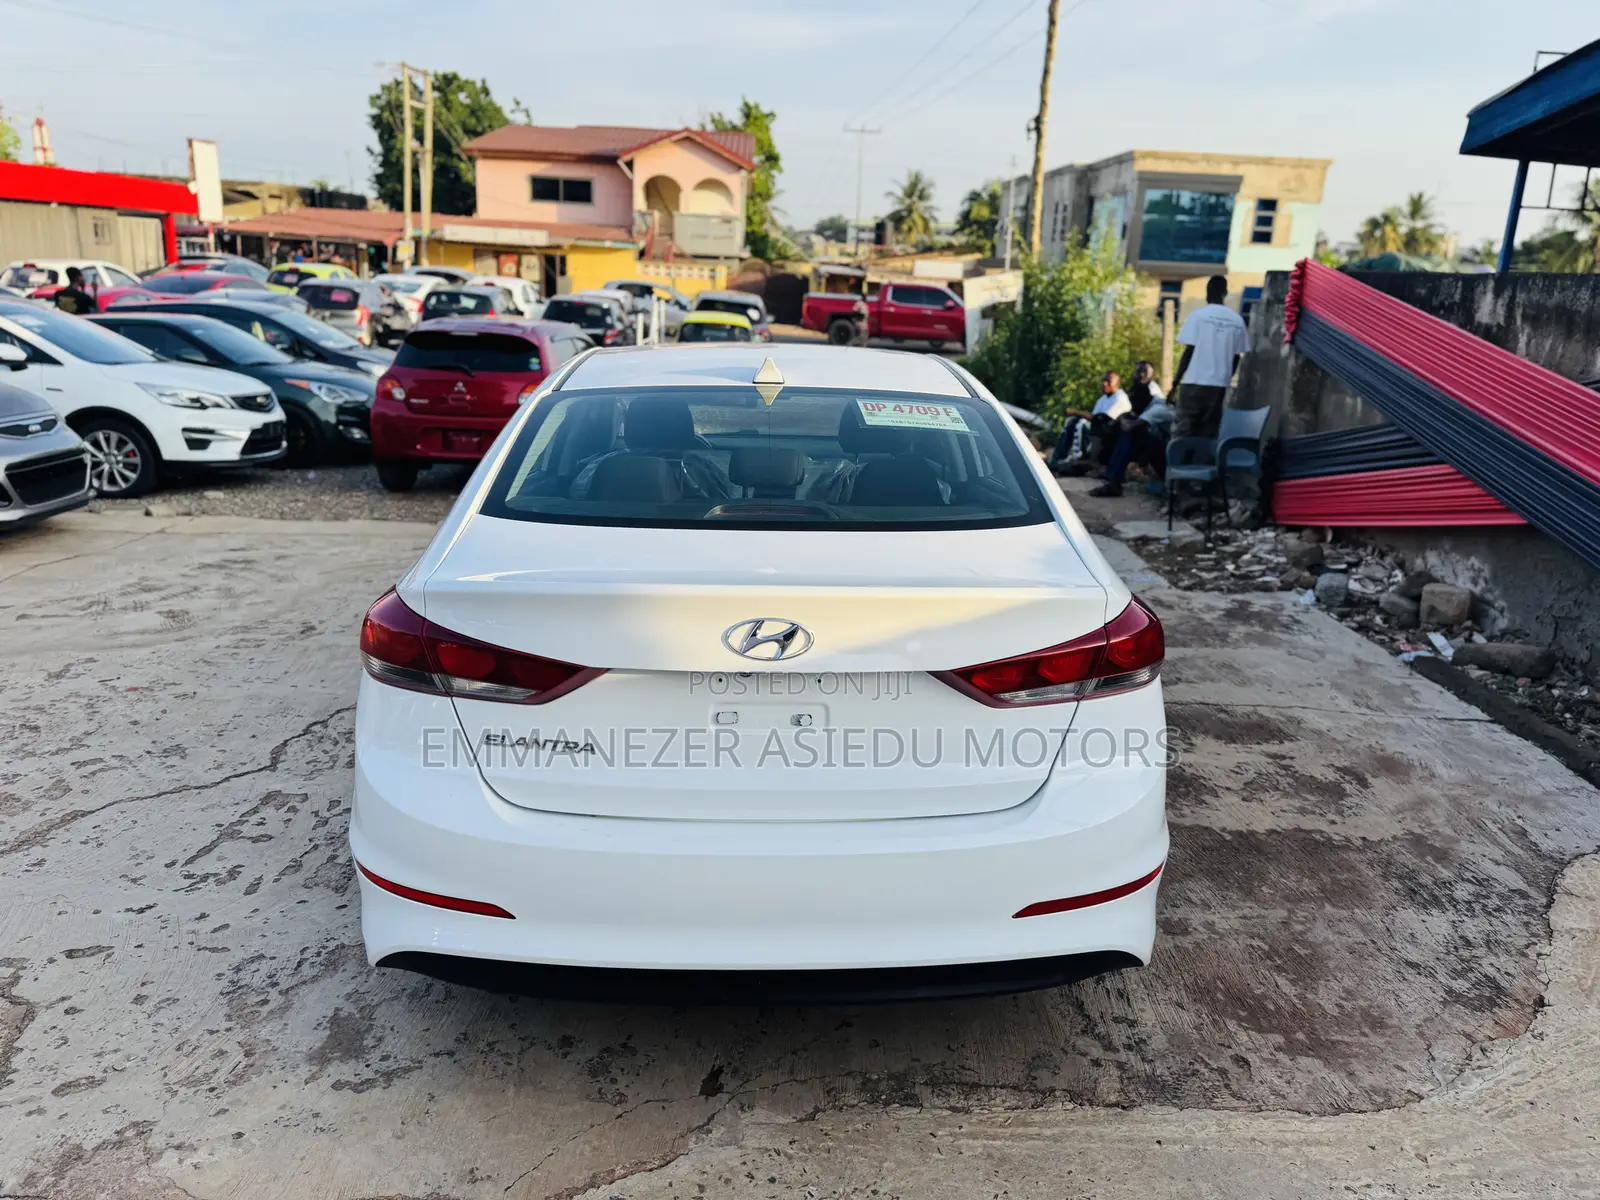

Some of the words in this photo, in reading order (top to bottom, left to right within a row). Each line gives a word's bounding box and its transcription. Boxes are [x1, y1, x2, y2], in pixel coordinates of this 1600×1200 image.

[892, 403, 941, 416] 4709
[942, 407, 954, 417] F
[484, 733, 597, 756] ELANTRA
